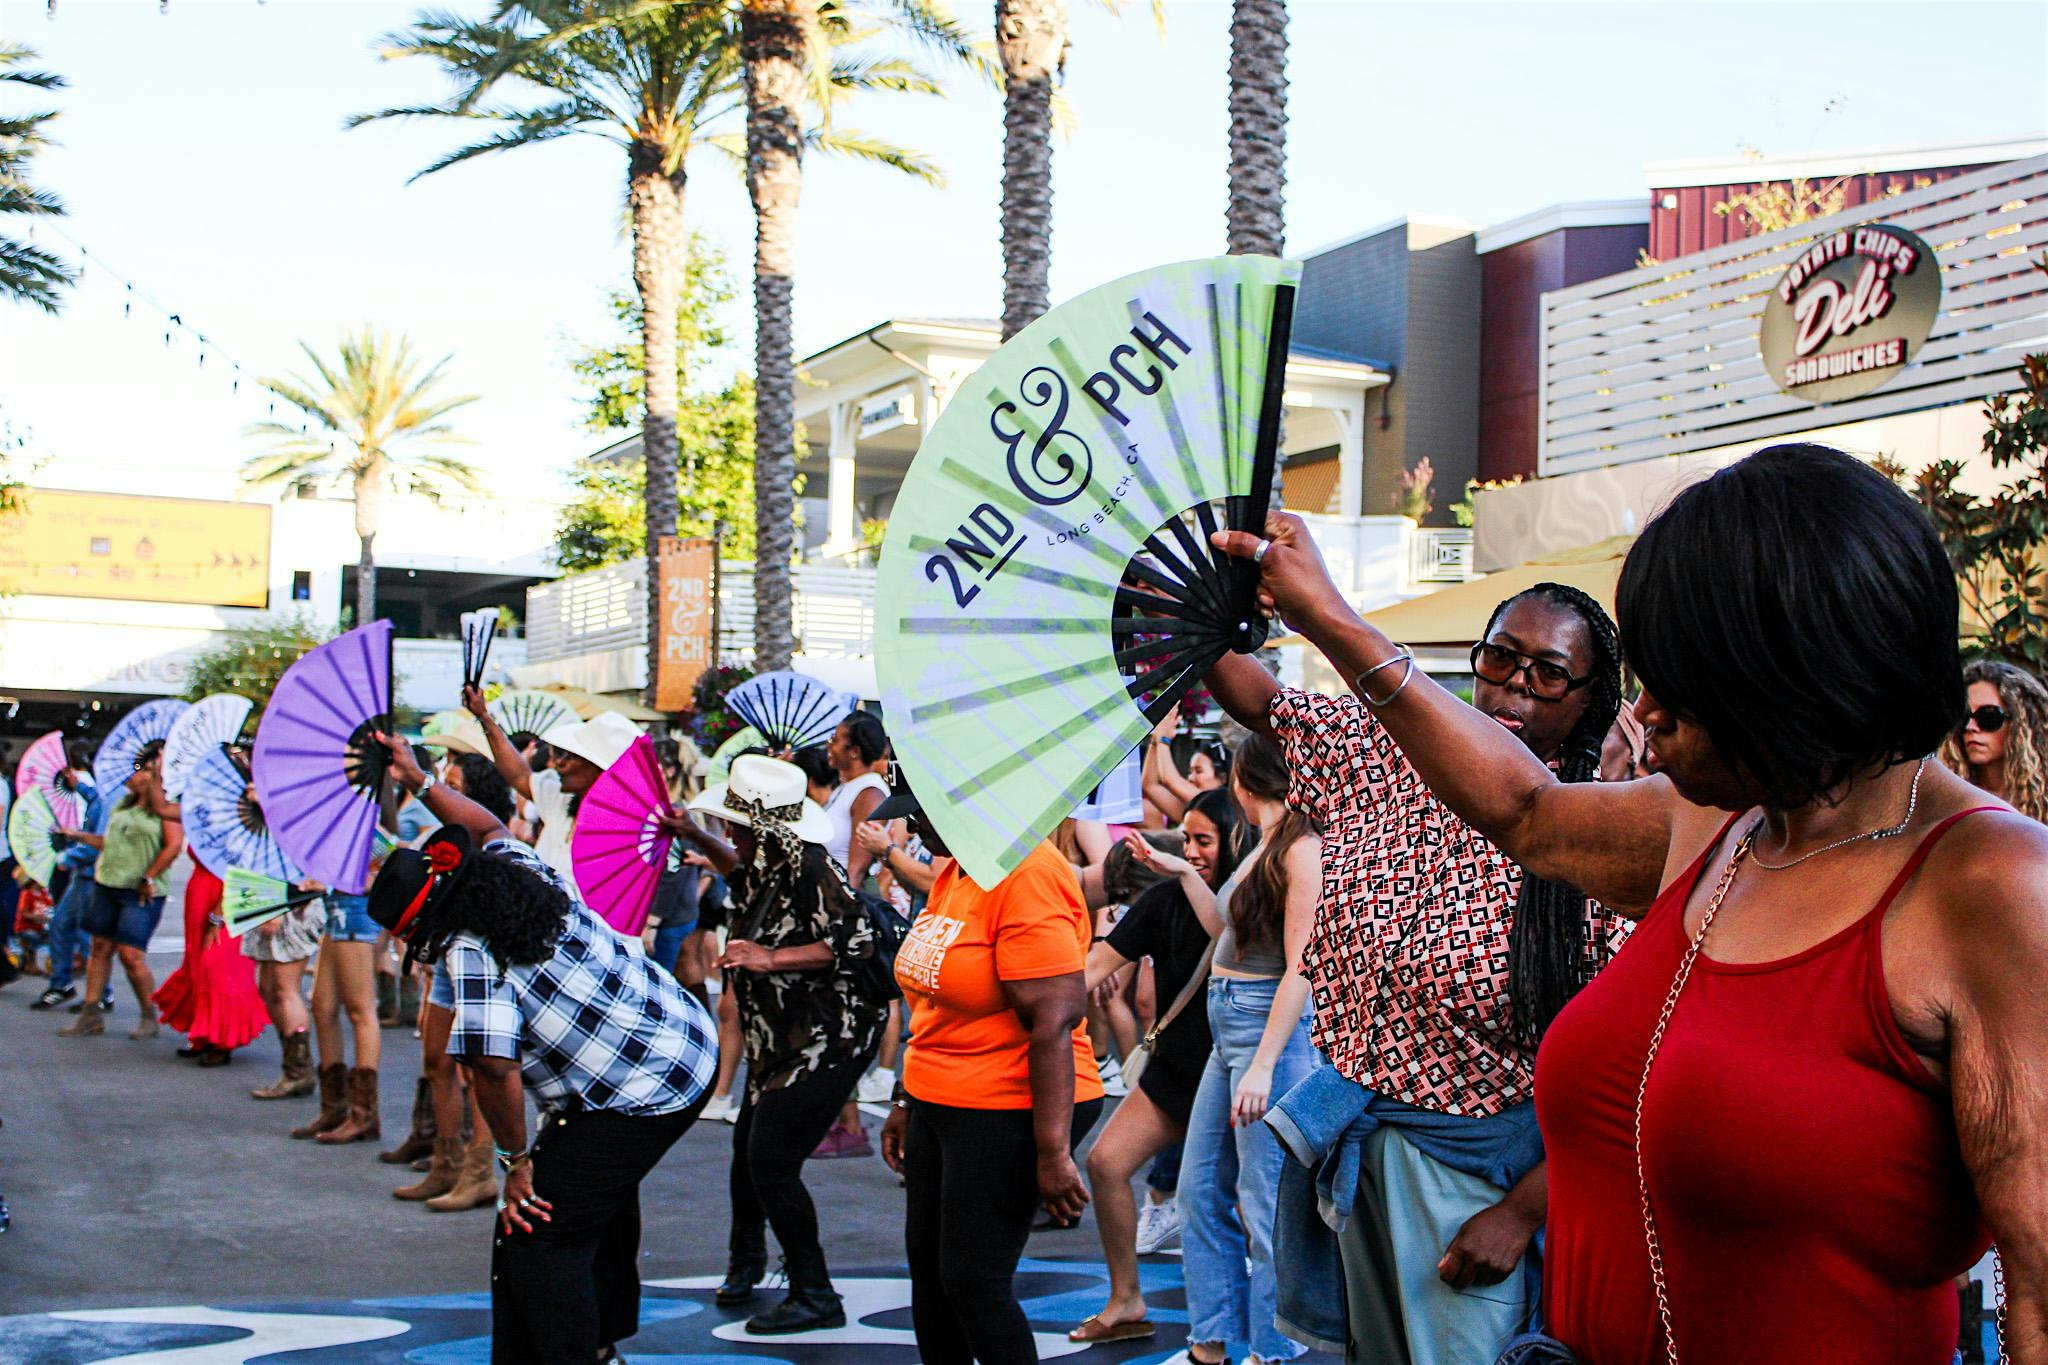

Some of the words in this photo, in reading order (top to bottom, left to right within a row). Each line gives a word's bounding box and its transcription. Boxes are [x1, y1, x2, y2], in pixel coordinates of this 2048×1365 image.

[1779, 232, 1851, 304] POTATO
[1854, 228, 1916, 275] CHIPS
[1795, 259, 1892, 356] Deli
[1785, 339, 1903, 387] SANDWICHES
[925, 503, 1022, 608] 2ND
[991, 366, 1092, 506] &
[1081, 311, 1192, 427] PCH
[1047, 523, 1090, 546] LONG
[1093, 474, 1135, 525] BEACH,
[1126, 442, 1138, 465] CA
[666, 577, 705, 602] 2ND
[671, 600, 705, 635] &
[666, 635, 705, 661] PCH
